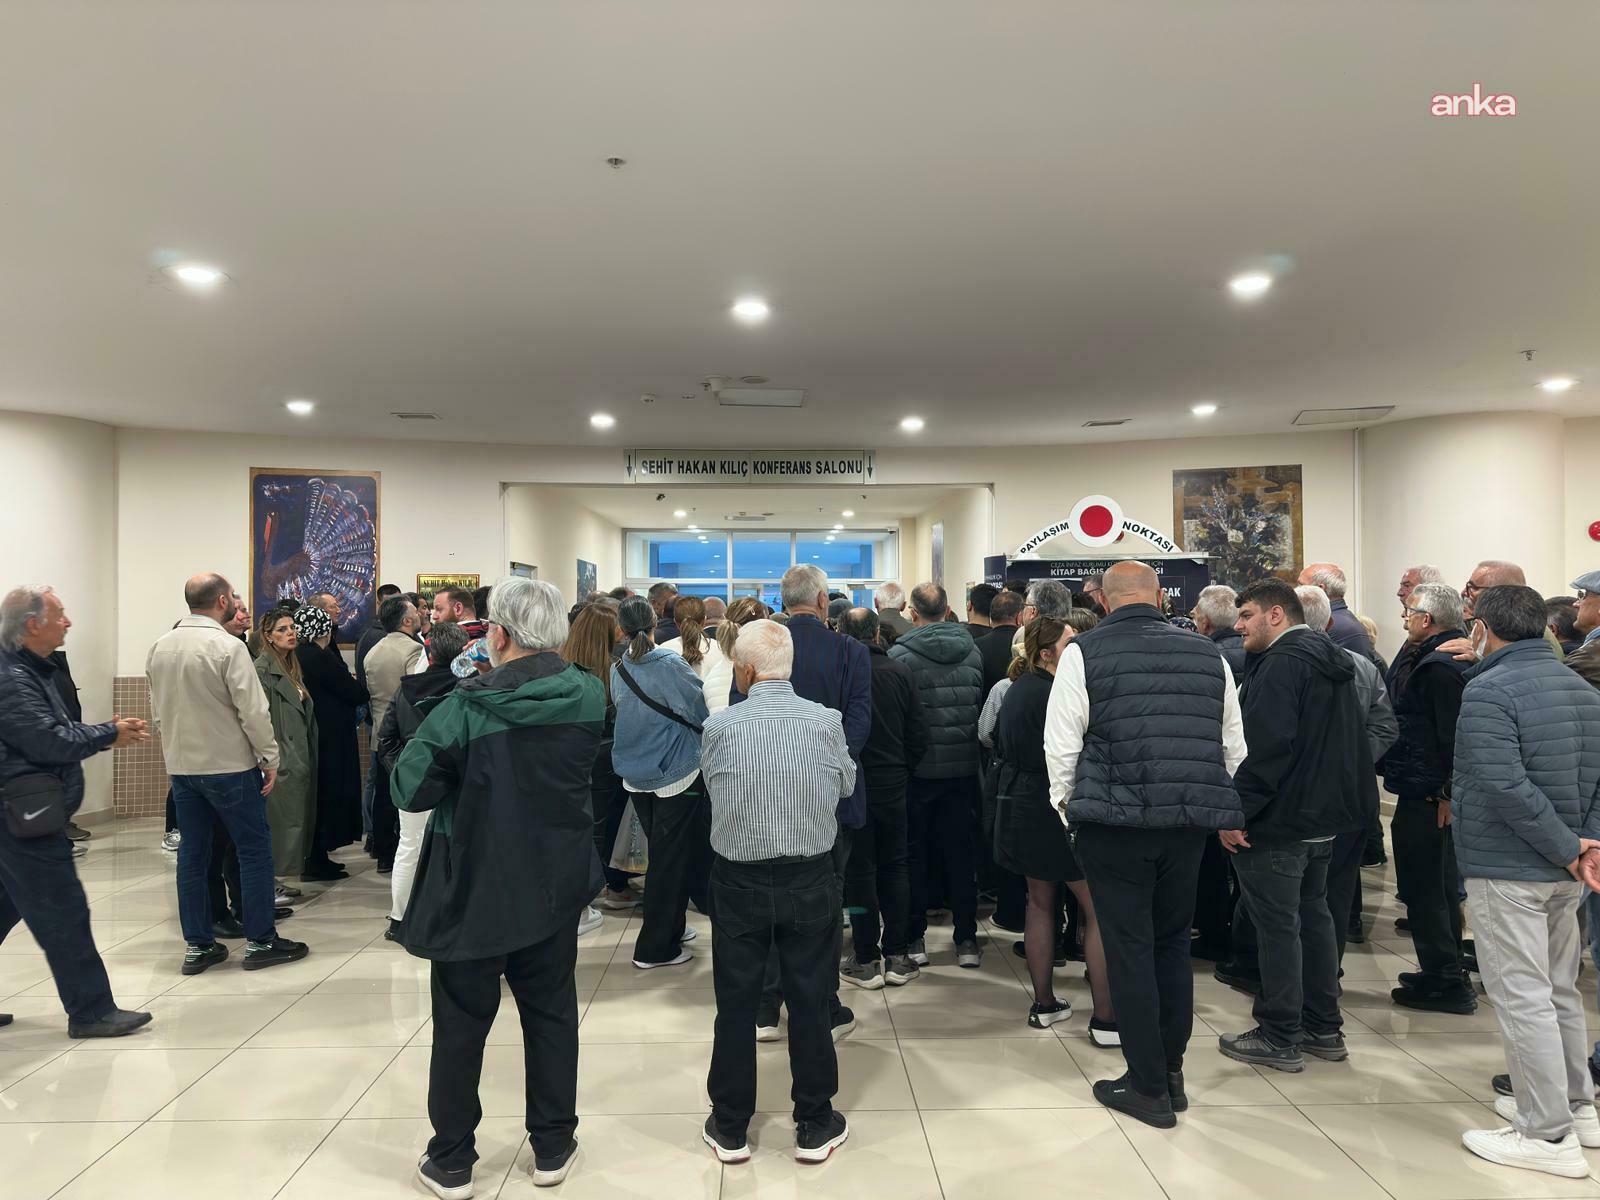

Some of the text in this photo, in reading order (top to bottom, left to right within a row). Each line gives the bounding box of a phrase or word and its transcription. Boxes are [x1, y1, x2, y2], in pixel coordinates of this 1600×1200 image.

[677, 460, 716, 474] HAKAN
[720, 460, 748, 477] KILIÇ
[753, 460, 812, 475] KONFERANS
[815, 459, 862, 474] SALONU
[1122, 521, 1174, 552] NOKTASI
[1050, 567, 1075, 576] KİTAP
